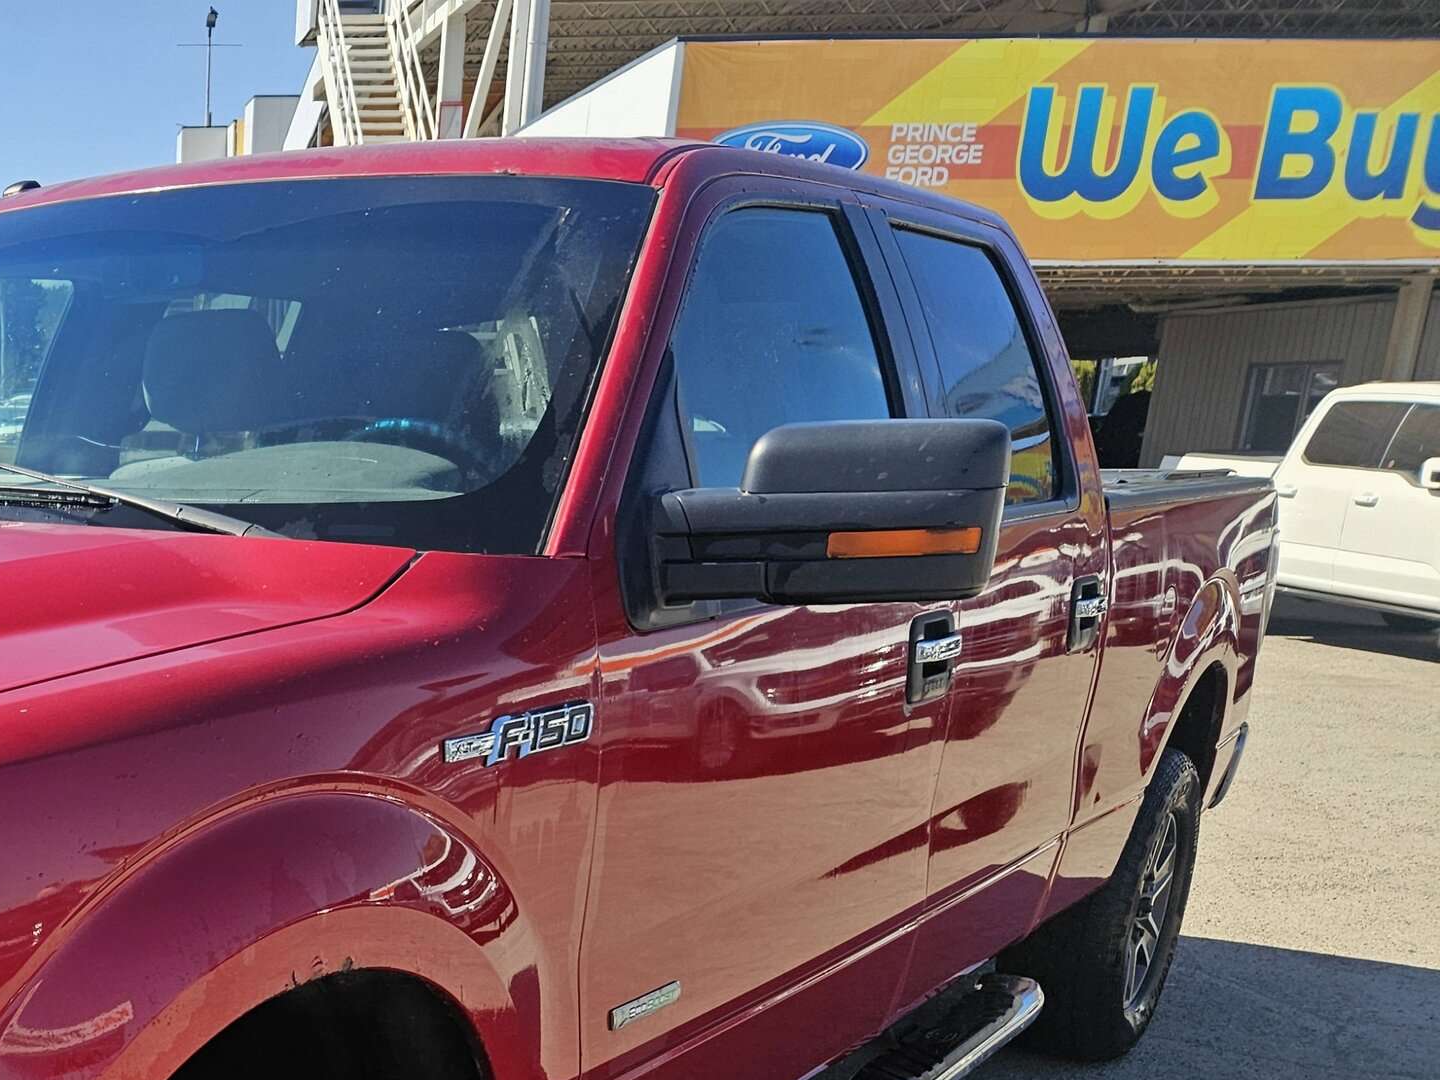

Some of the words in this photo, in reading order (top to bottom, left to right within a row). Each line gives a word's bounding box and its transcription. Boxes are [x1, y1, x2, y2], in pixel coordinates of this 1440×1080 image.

[891, 123, 977, 143] PRINCE
[887, 144, 984, 165] GEORGE
[1018, 85, 1222, 204] We
[885, 166, 949, 187] FORD
